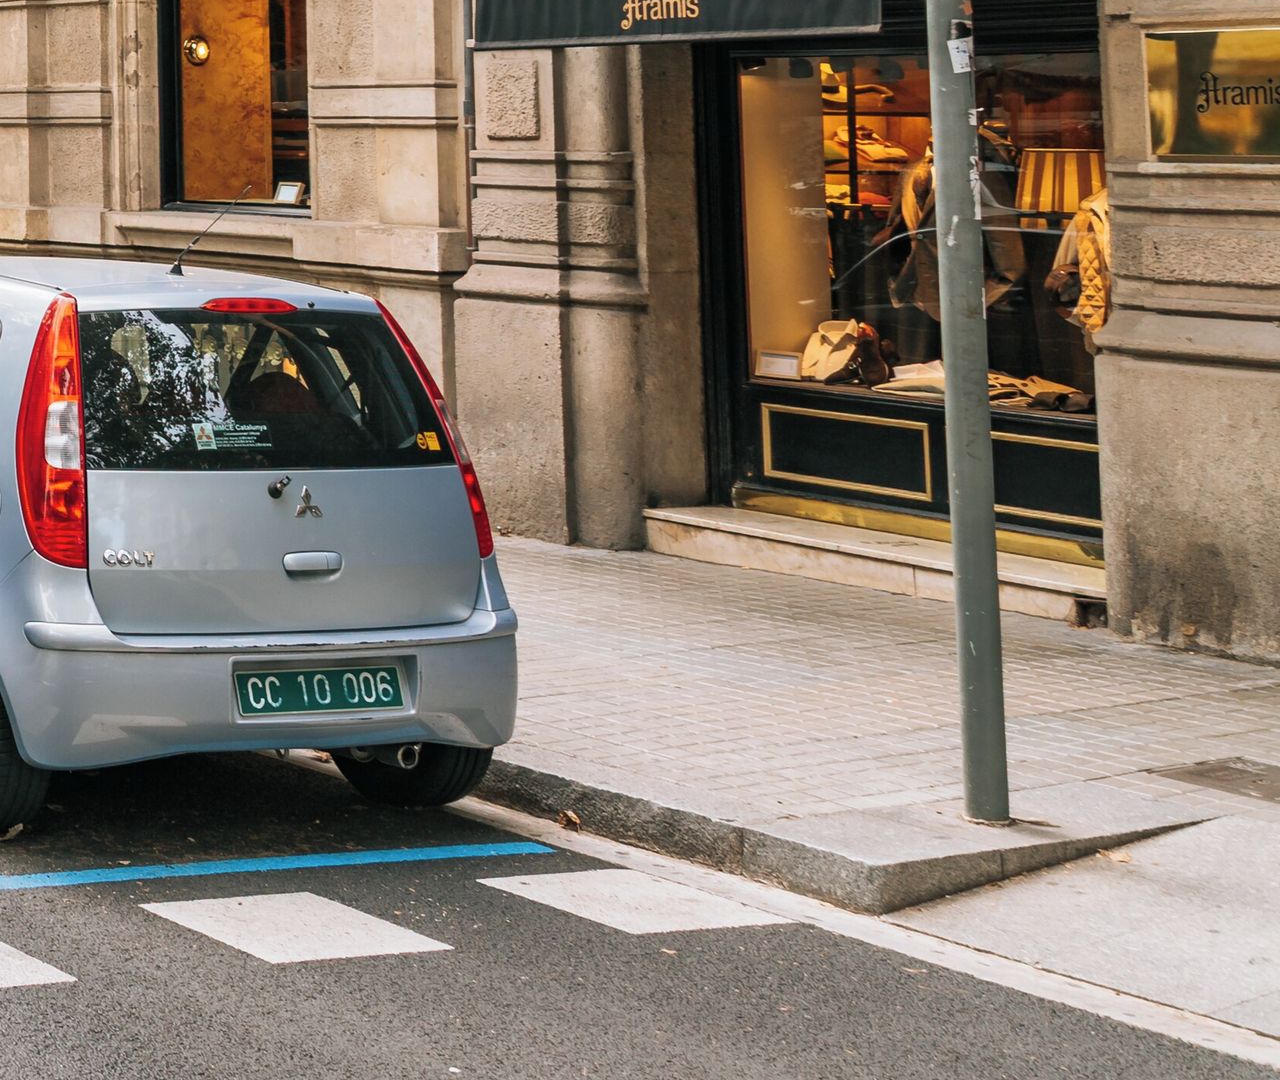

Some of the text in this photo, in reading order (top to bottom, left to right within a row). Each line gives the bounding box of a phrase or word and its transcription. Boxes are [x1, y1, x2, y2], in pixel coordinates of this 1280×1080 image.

[235, 424, 268, 432] Catalunya
[103, 549, 155, 568] COLT
[247, 671, 394, 709] CC 10 006
